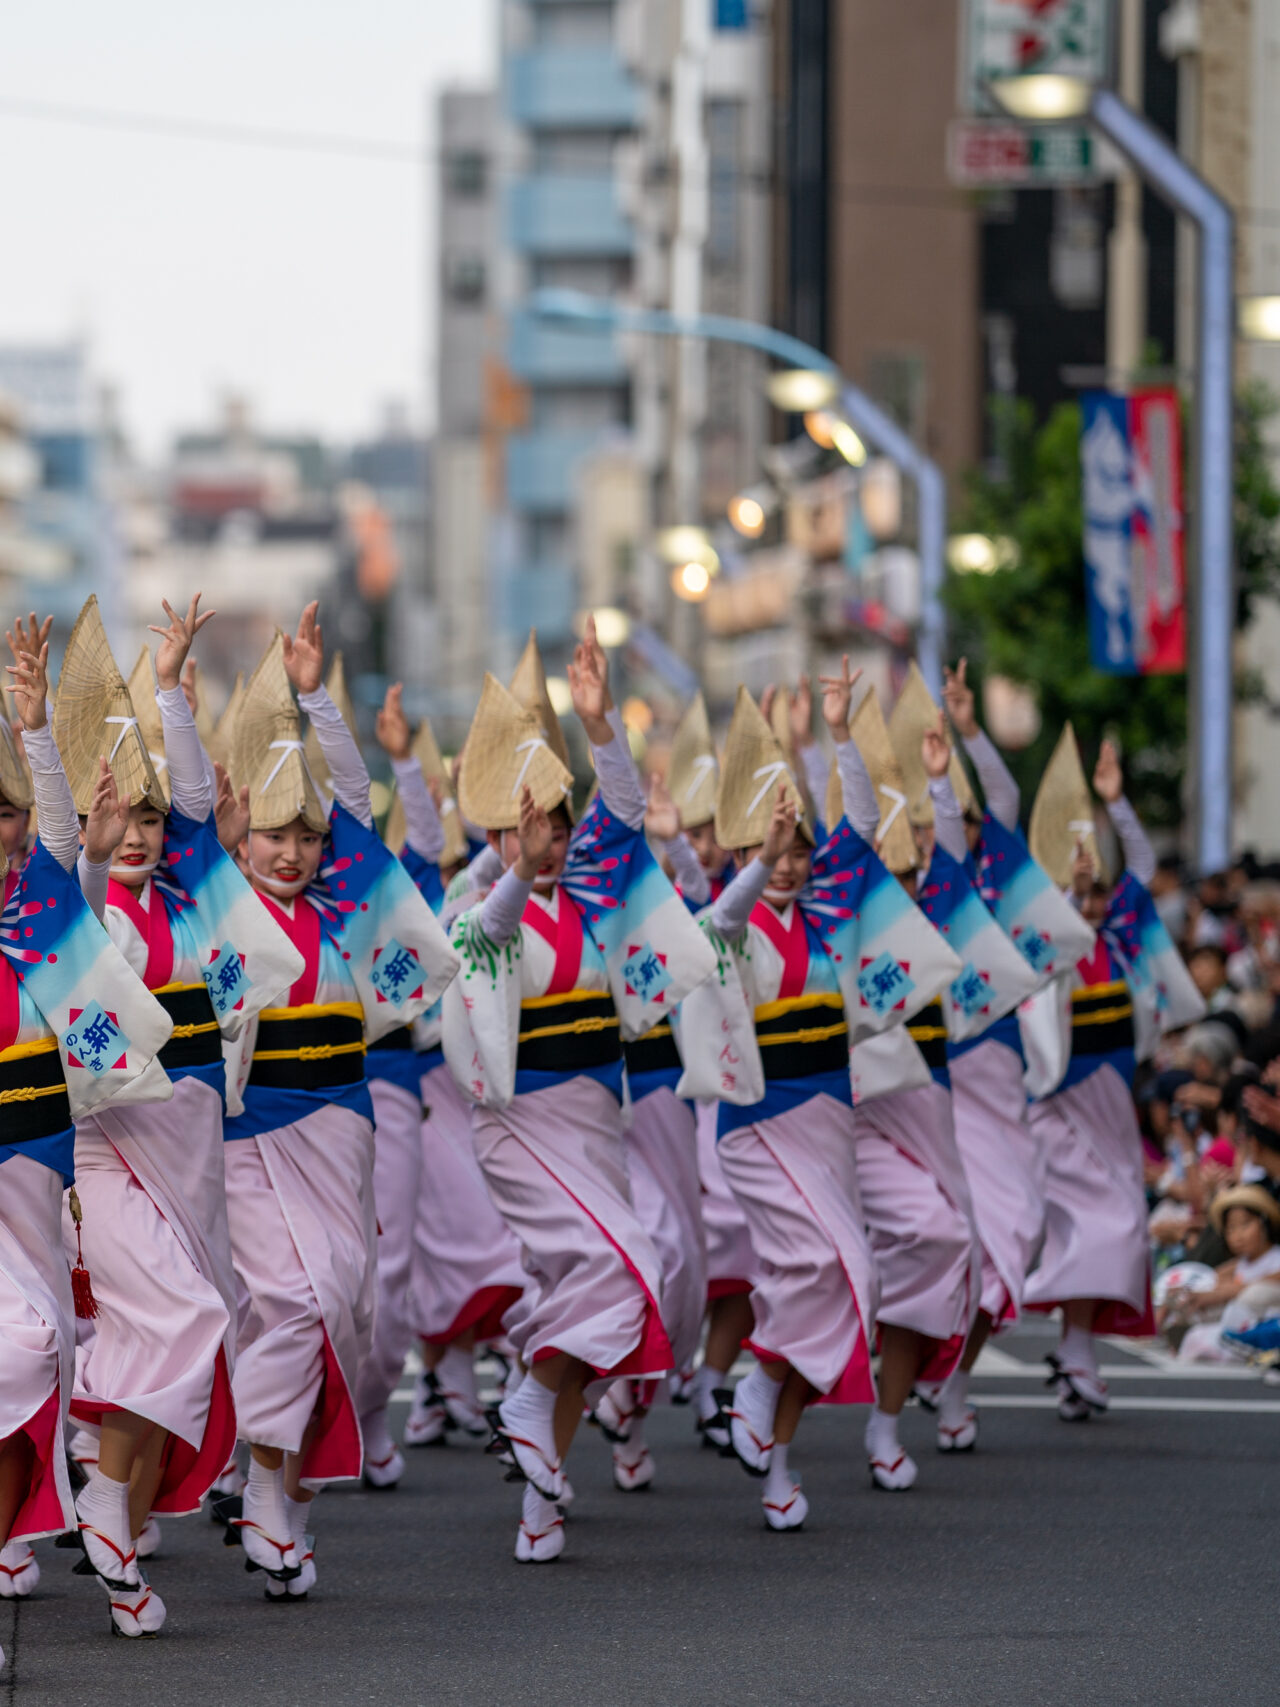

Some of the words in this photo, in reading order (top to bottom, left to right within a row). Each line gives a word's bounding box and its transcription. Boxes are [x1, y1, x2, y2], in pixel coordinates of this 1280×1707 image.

[218, 954, 241, 994] 新
[372, 971, 402, 1003] のんき
[384, 949, 417, 987] 新
[639, 954, 661, 987] 新
[872, 962, 903, 996] 新
[202, 972, 227, 1011] のんき
[66, 1033, 105, 1072] のんき
[83, 1013, 118, 1054] 新
